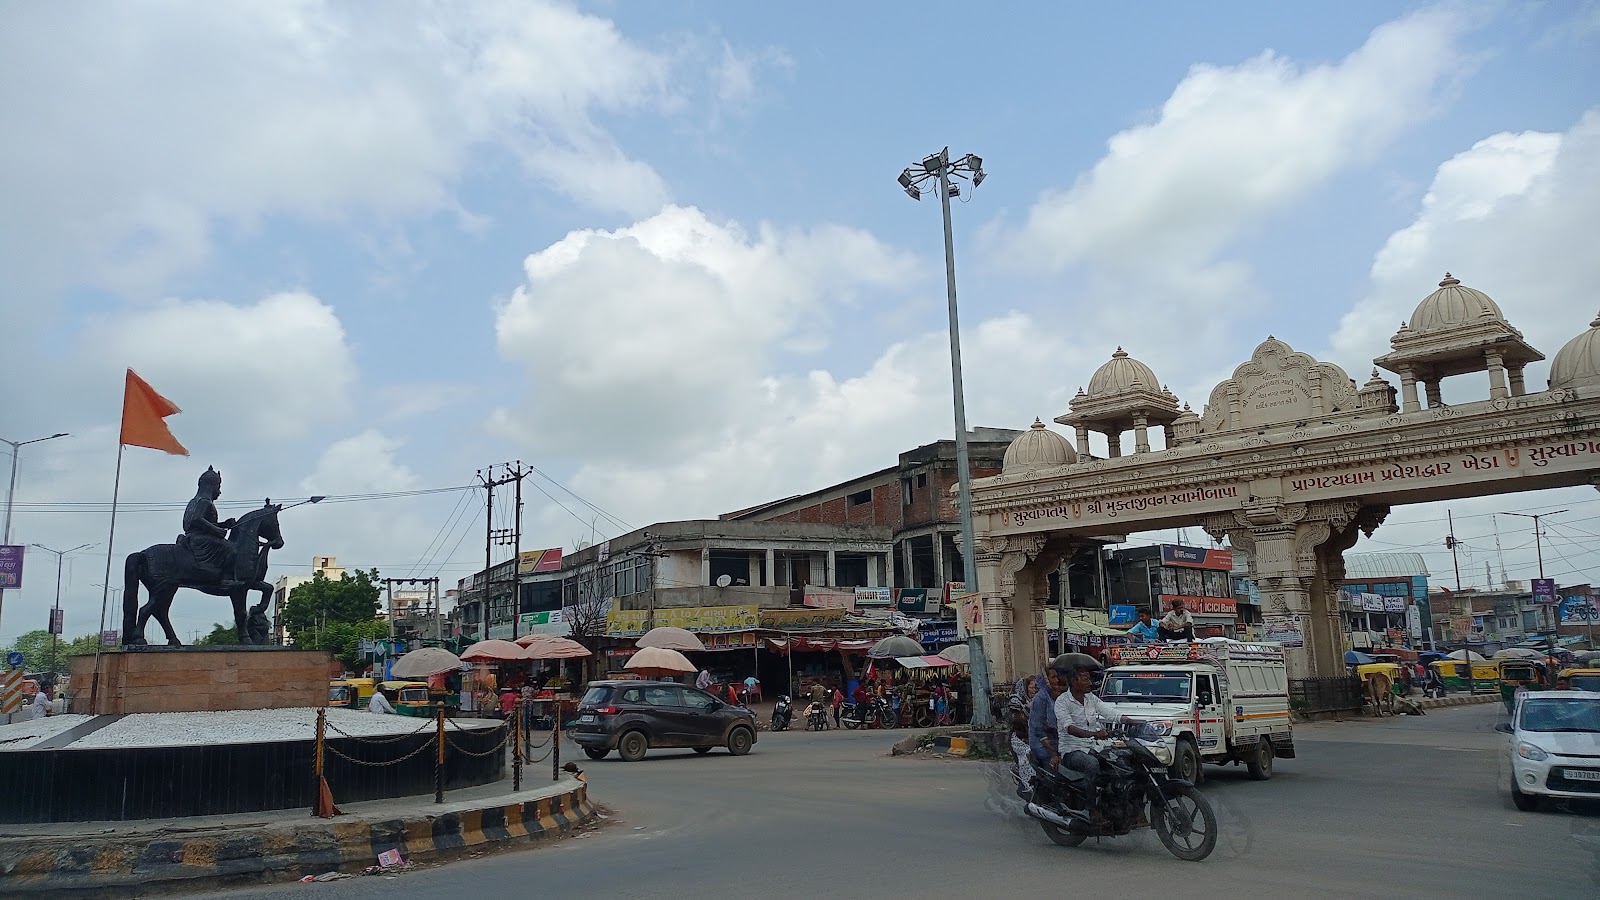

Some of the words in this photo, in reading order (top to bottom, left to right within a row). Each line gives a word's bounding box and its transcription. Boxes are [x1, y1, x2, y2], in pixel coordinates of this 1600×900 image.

[1380, 461, 1452, 482] પ્રવેશદ્વાર
[1462, 454, 1500, 471] ખેડા
[1087, 500, 1102, 514] શ્રી
[1106, 495, 1168, 517] મુક્તજીવન
[1170, 486, 1239, 505] સ્વામીબાપા
[1013, 505, 1069, 526] સુસ્વાગતમ્
[681, 609, 691, 618] to
[694, 608, 701, 617] Z
[1205, 603, 1220, 612] ICICI
[1221, 603, 1237, 613] Bank
